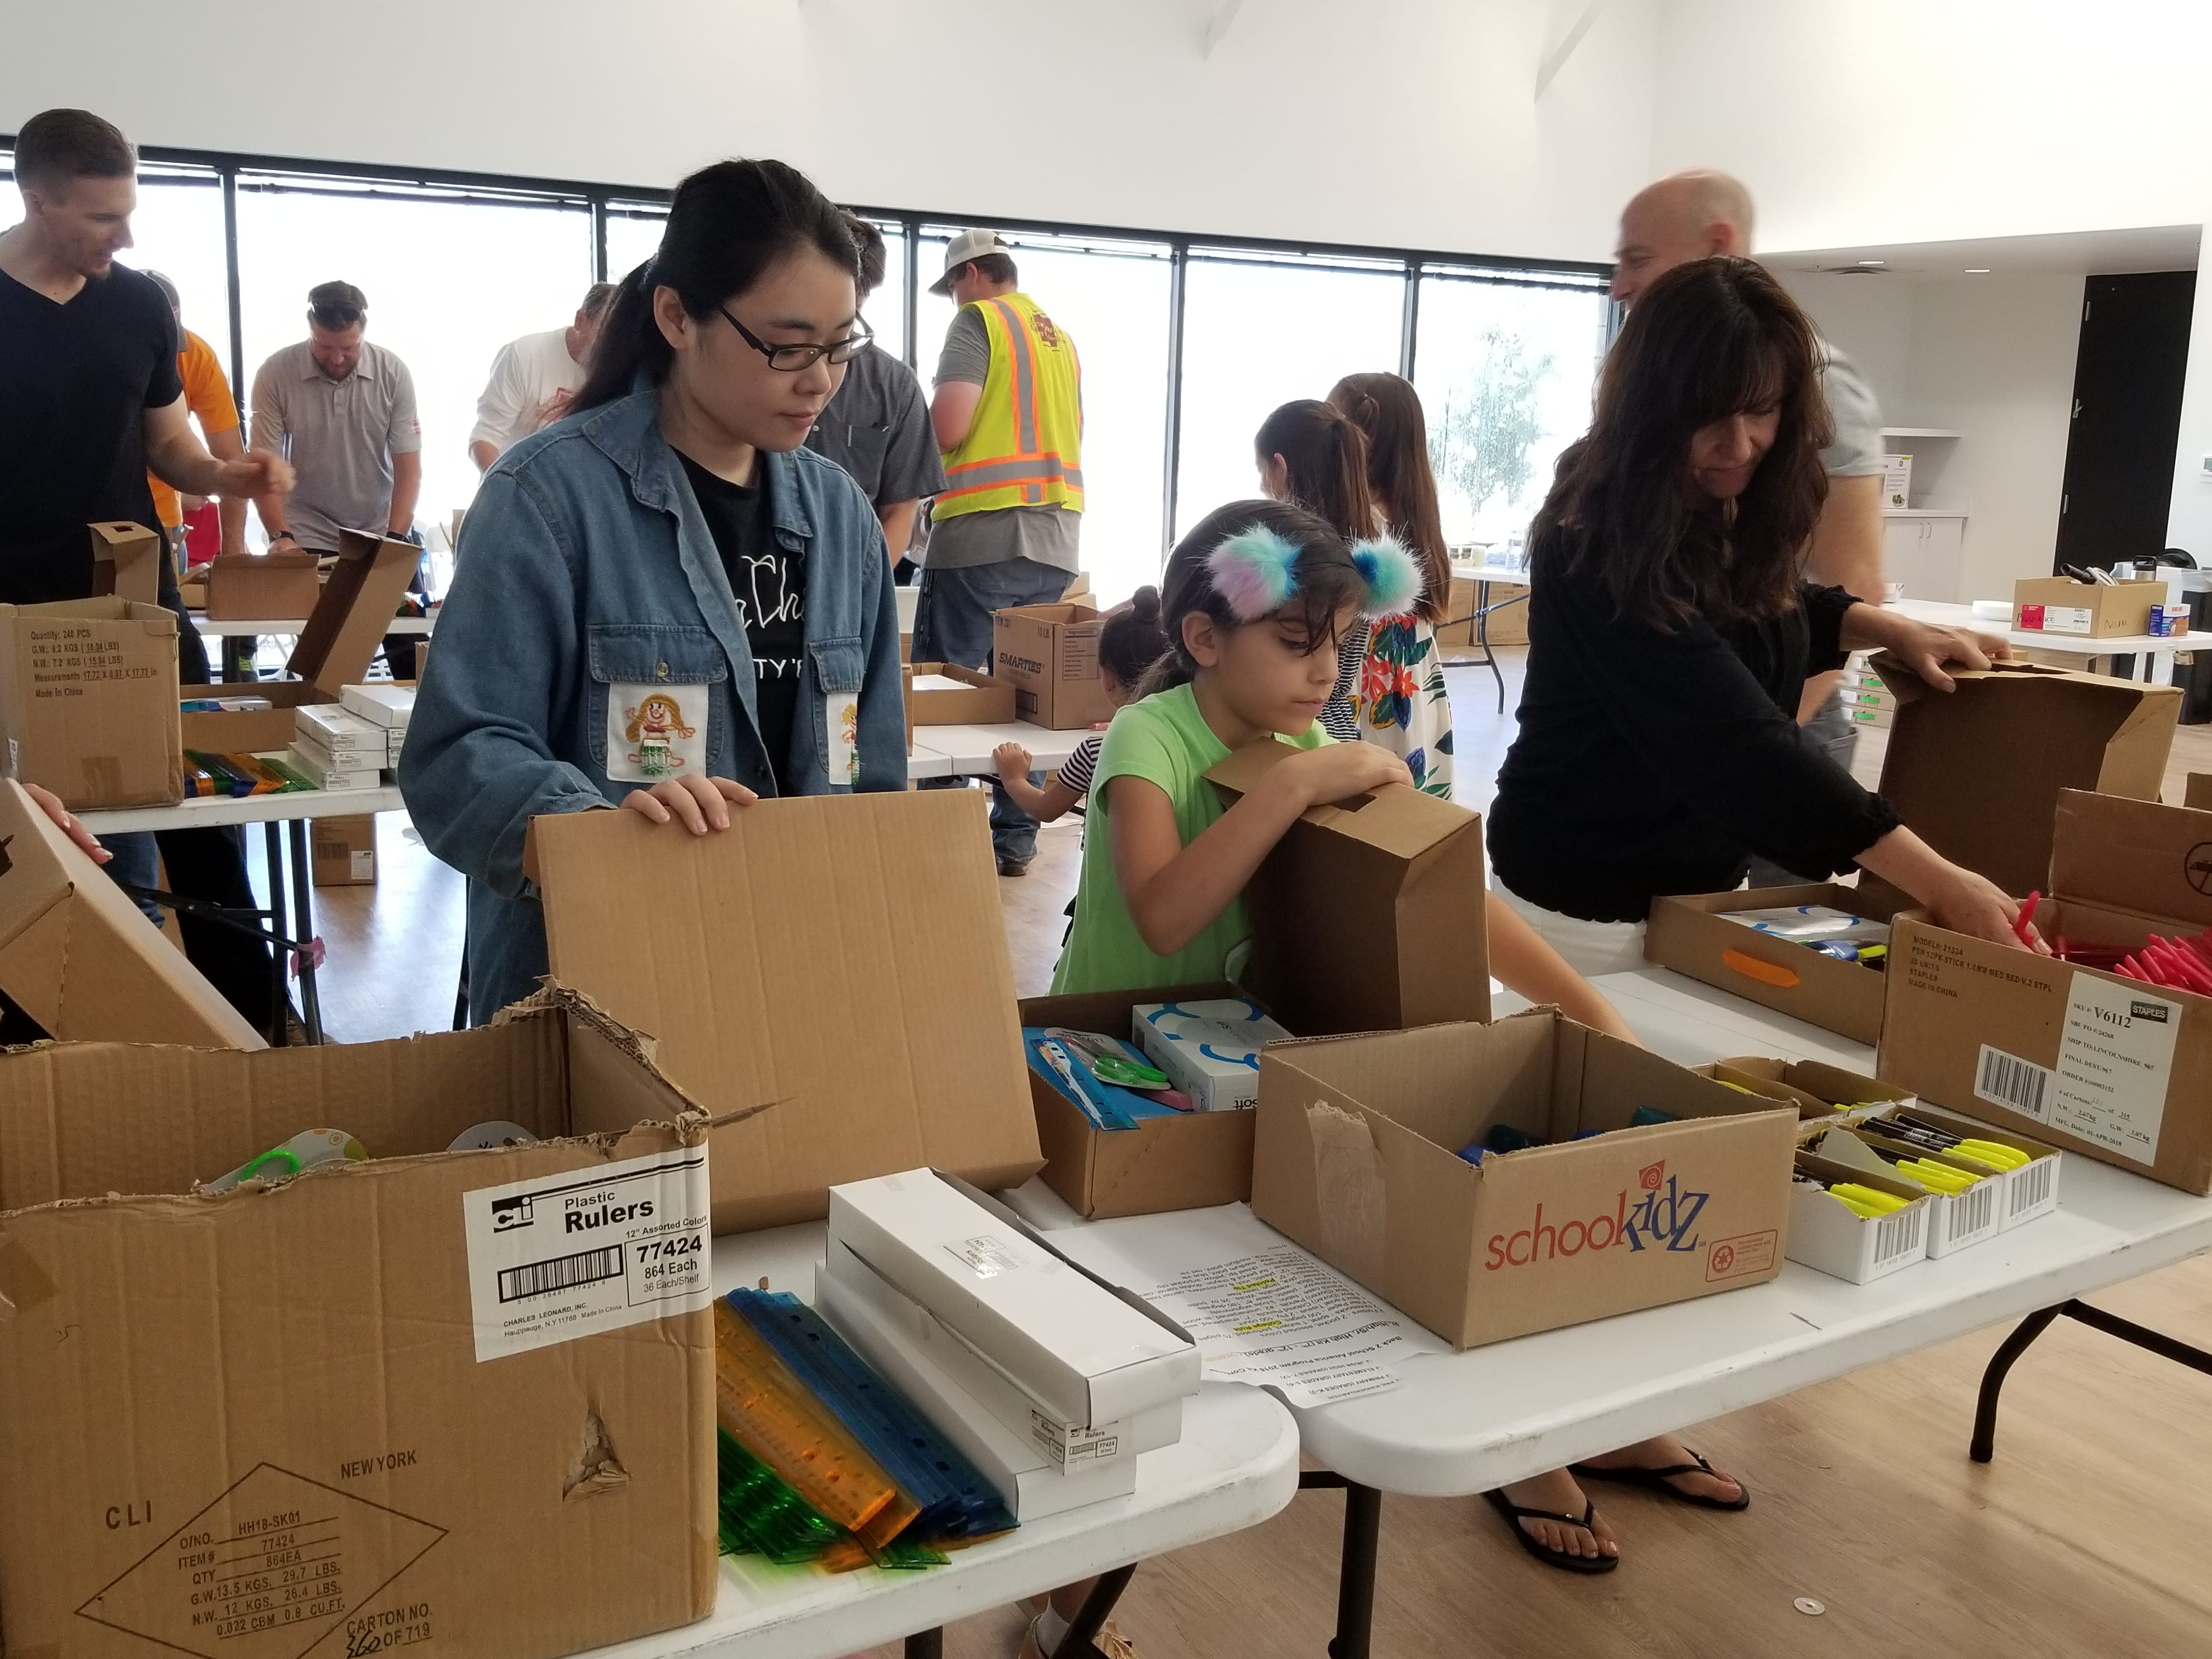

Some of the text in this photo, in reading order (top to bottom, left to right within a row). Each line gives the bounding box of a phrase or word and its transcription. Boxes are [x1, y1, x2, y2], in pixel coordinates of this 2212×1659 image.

[64, 644, 78, 652] KGS
[66, 658, 82, 667] KGS
[999, 652, 1042, 674] SMARTIES
[35, 673, 81, 682] Measurements
[36, 689, 53, 698] Made
[65, 687, 83, 697] China
[1912, 946, 1926, 956] PEN
[1926, 950, 1943, 961] 12PK
[1944, 954, 1965, 969] STICK
[1989, 968, 2004, 979] MED
[2005, 973, 2020, 984] RED
[1909, 967, 1938, 982] STAPLES
[1936, 986, 1958, 998] CHINA
[2094, 1006, 2132, 1029] V6112
[2132, 1003, 2166, 1019] STAPLES
[2067, 1036, 2083, 1046] SHIP
[2064, 1053, 2084, 1065] FINAL
[2062, 1070, 2084, 1082] ORDER
[565, 1192, 616, 1210] Plastic
[565, 1200, 654, 1234] Rulers
[626, 1214, 707, 1239] 12" Assorted Colors
[636, 1234, 703, 1263] 77424
[645, 1257, 698, 1279] 864 Each
[644, 1273, 700, 1293] 36 Each/Shelf
[503, 1302, 589, 1328] CHARLES LEONARD, INC.
[504, 1323, 544, 1338] Hauppauge,
[581, 1311, 597, 1319] Made
[605, 1304, 623, 1313] China
[1253, 1320, 1282, 1328] College
[1330, 1333, 1353, 1342] High
[1381, 1335, 1403, 1347] Back
[1314, 1352, 1347, 1362] America
[1347, 1346, 1375, 1357] School
[1279, 1358, 1314, 1369] Program
[1301, 1367, 1375, 1385] ELEMENTARY (GRADES
[1356, 1374, 1385, 1385] PRIMARY
[1324, 1381, 1355, 1392] (GRADES
[1085, 1430, 1105, 1439] Rulers
[341, 1449, 417, 1479] NEW YORK
[105, 1499, 153, 1530] CLI
[178, 1552, 206, 1570] ITEM
[261, 1533, 295, 1551] 77424
[192, 1549, 302, 1585] QTY 864EA
[283, 1567, 306, 1583] 29.7
[315, 1561, 341, 1577] LBS.
[193, 1609, 218, 1626] N.W.
[225, 1602, 238, 1616] 12
[316, 1580, 341, 1596] LBS.
[217, 1619, 246, 1636] 0.022
[251, 1613, 275, 1629] CBM
[346, 1602, 433, 1635] CARTON NO.
[383, 1629, 402, 1647] OF
